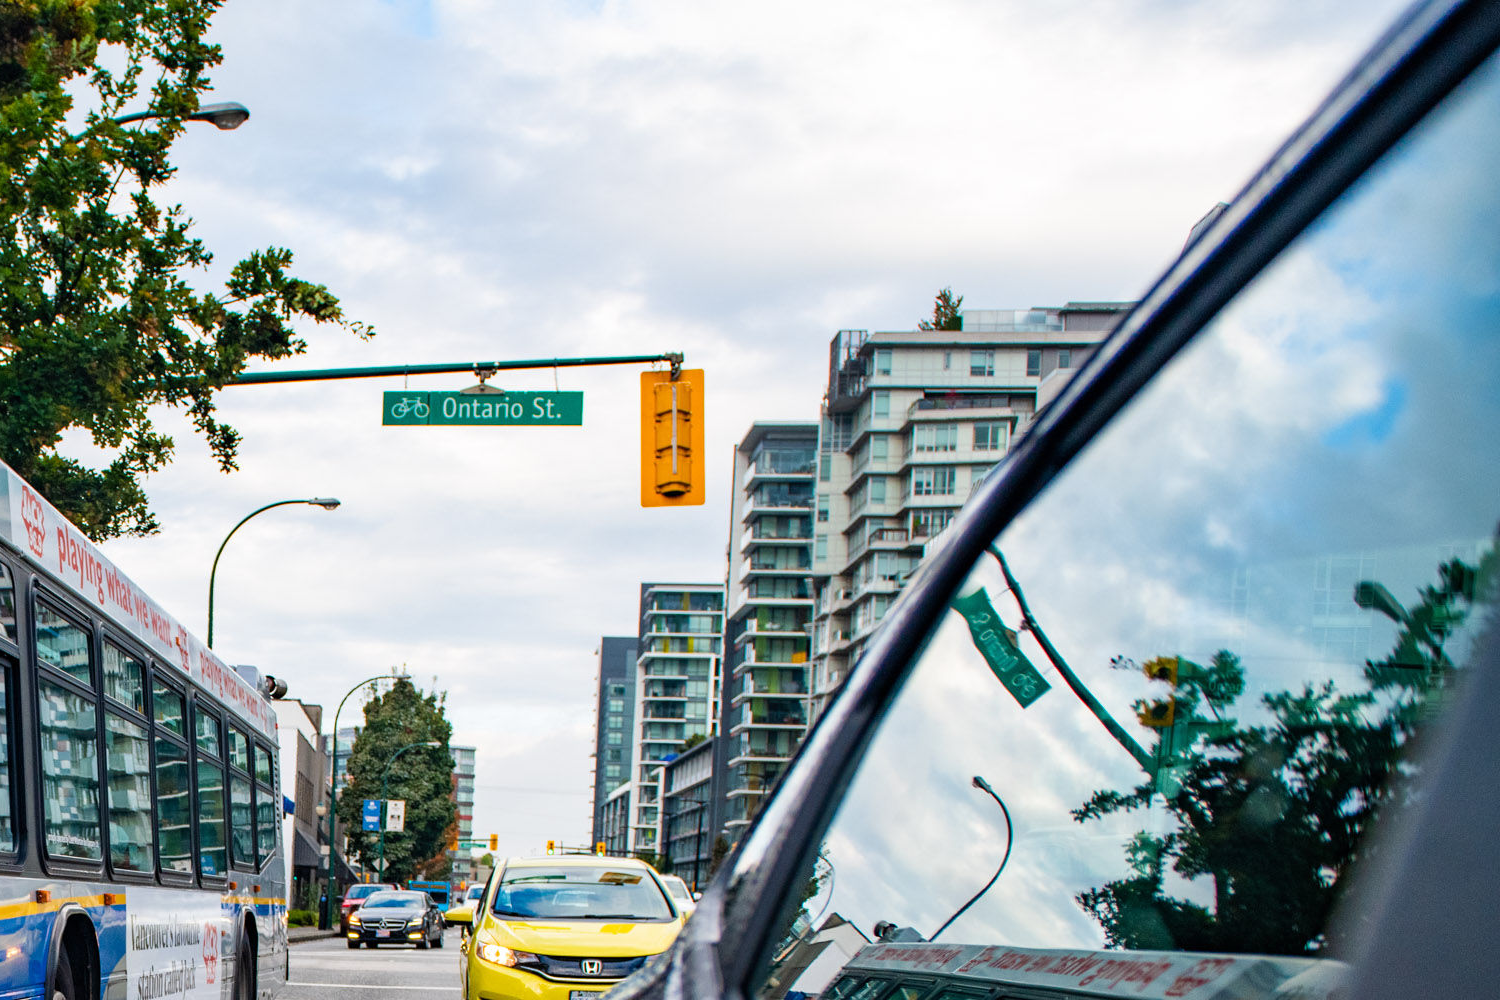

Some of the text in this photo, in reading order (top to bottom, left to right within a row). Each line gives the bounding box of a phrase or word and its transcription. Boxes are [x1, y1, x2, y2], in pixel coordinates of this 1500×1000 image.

[443, 397, 562, 418] Ontario St.
[57, 524, 105, 605] playing
[105, 567, 133, 616] what
[134, 593, 149, 629] we
[150, 606, 172, 648] want
[200, 648, 223, 698] playing
[164, 960, 183, 996] called
